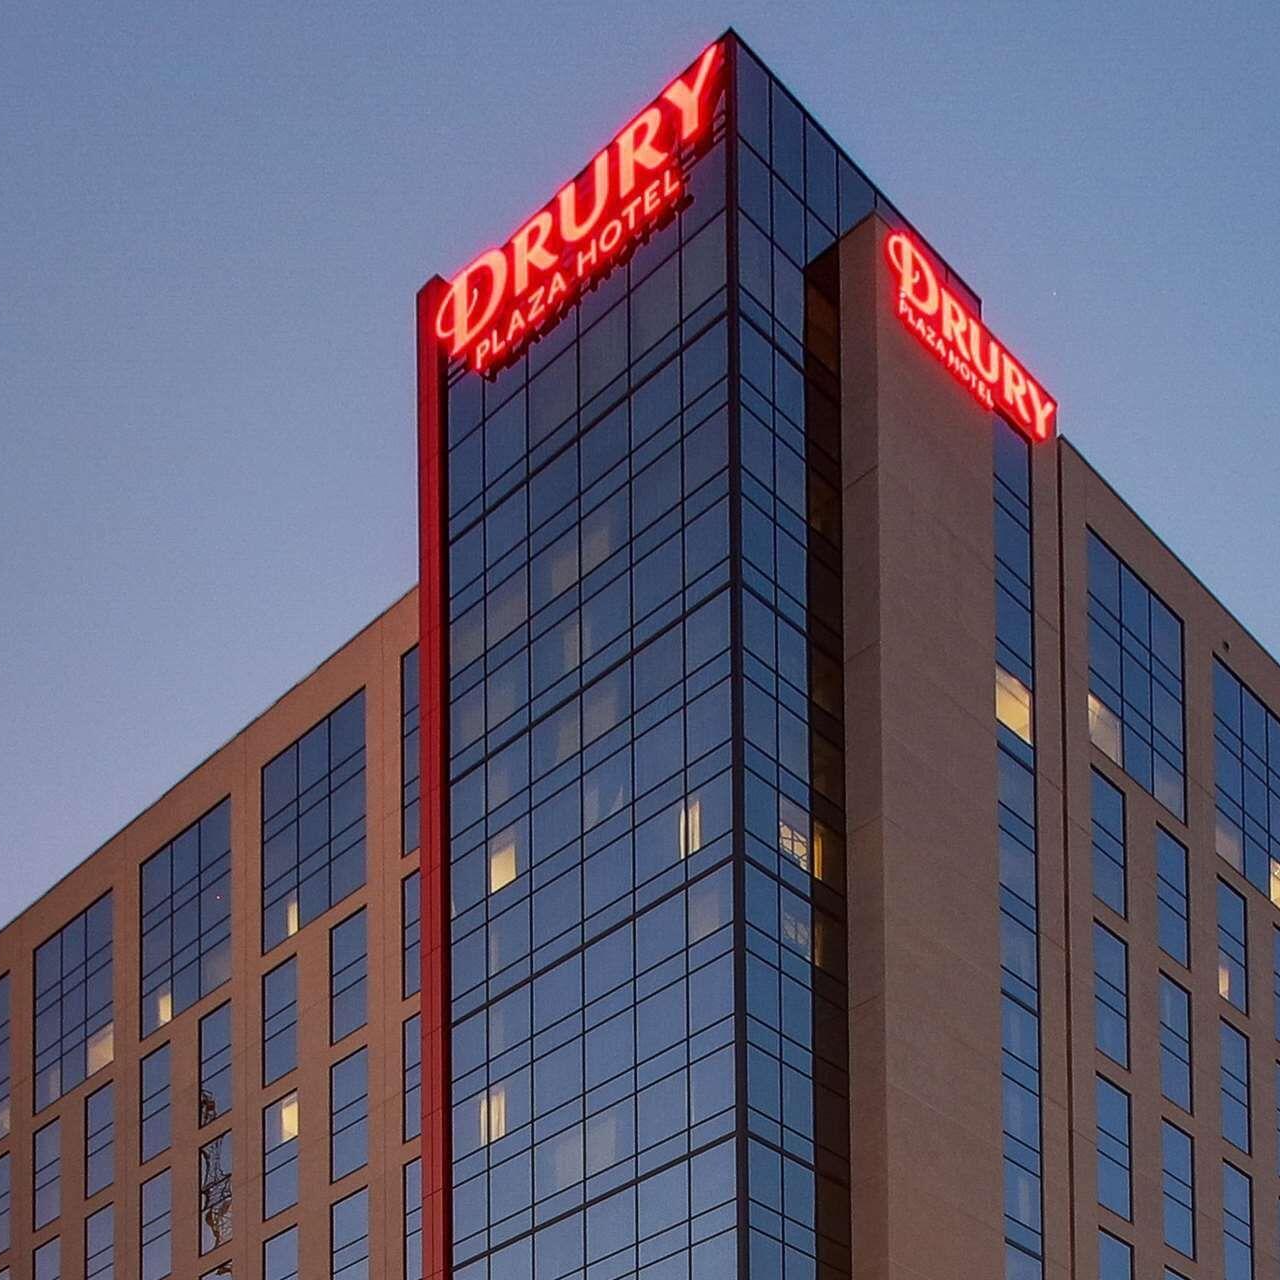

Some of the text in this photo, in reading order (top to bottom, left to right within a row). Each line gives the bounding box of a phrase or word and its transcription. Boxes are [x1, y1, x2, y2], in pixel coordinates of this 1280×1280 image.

[435, 44, 718, 357] DRURY
[476, 169, 680, 370] PLAZA HOTEL
[888, 234, 1055, 438] DRURY
[899, 298, 994, 408] PLAZA HOTEL
